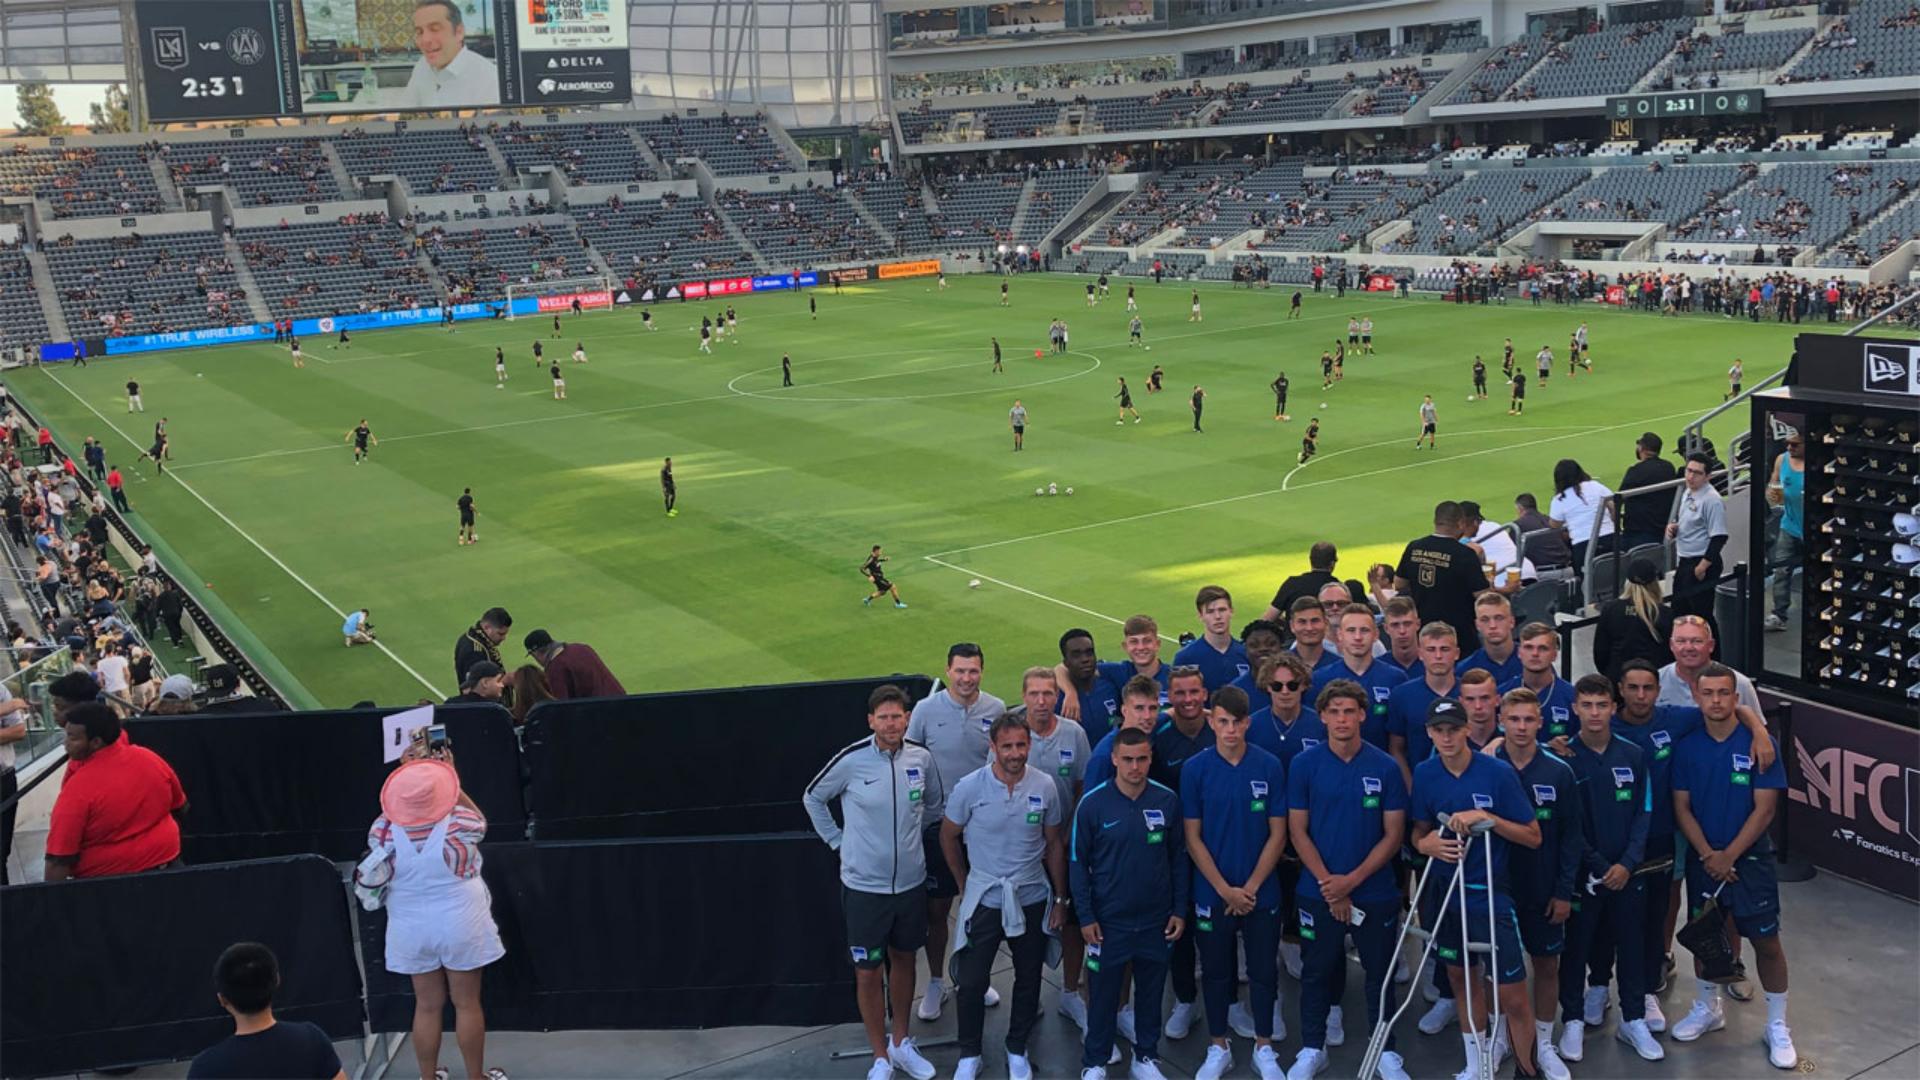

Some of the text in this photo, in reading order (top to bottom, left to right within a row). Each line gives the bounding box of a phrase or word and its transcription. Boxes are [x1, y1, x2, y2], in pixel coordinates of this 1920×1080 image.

[561, 57, 604, 67] DELTA
[181, 76, 243, 97] 2:31
[1665, 98, 1695, 112] 2:31
[427, 303, 480, 317] WILESS
[159, 331, 190, 344] TRUE
[195, 325, 255, 340] WIRELESS
[1856, 835, 1900, 859] Fanatics
